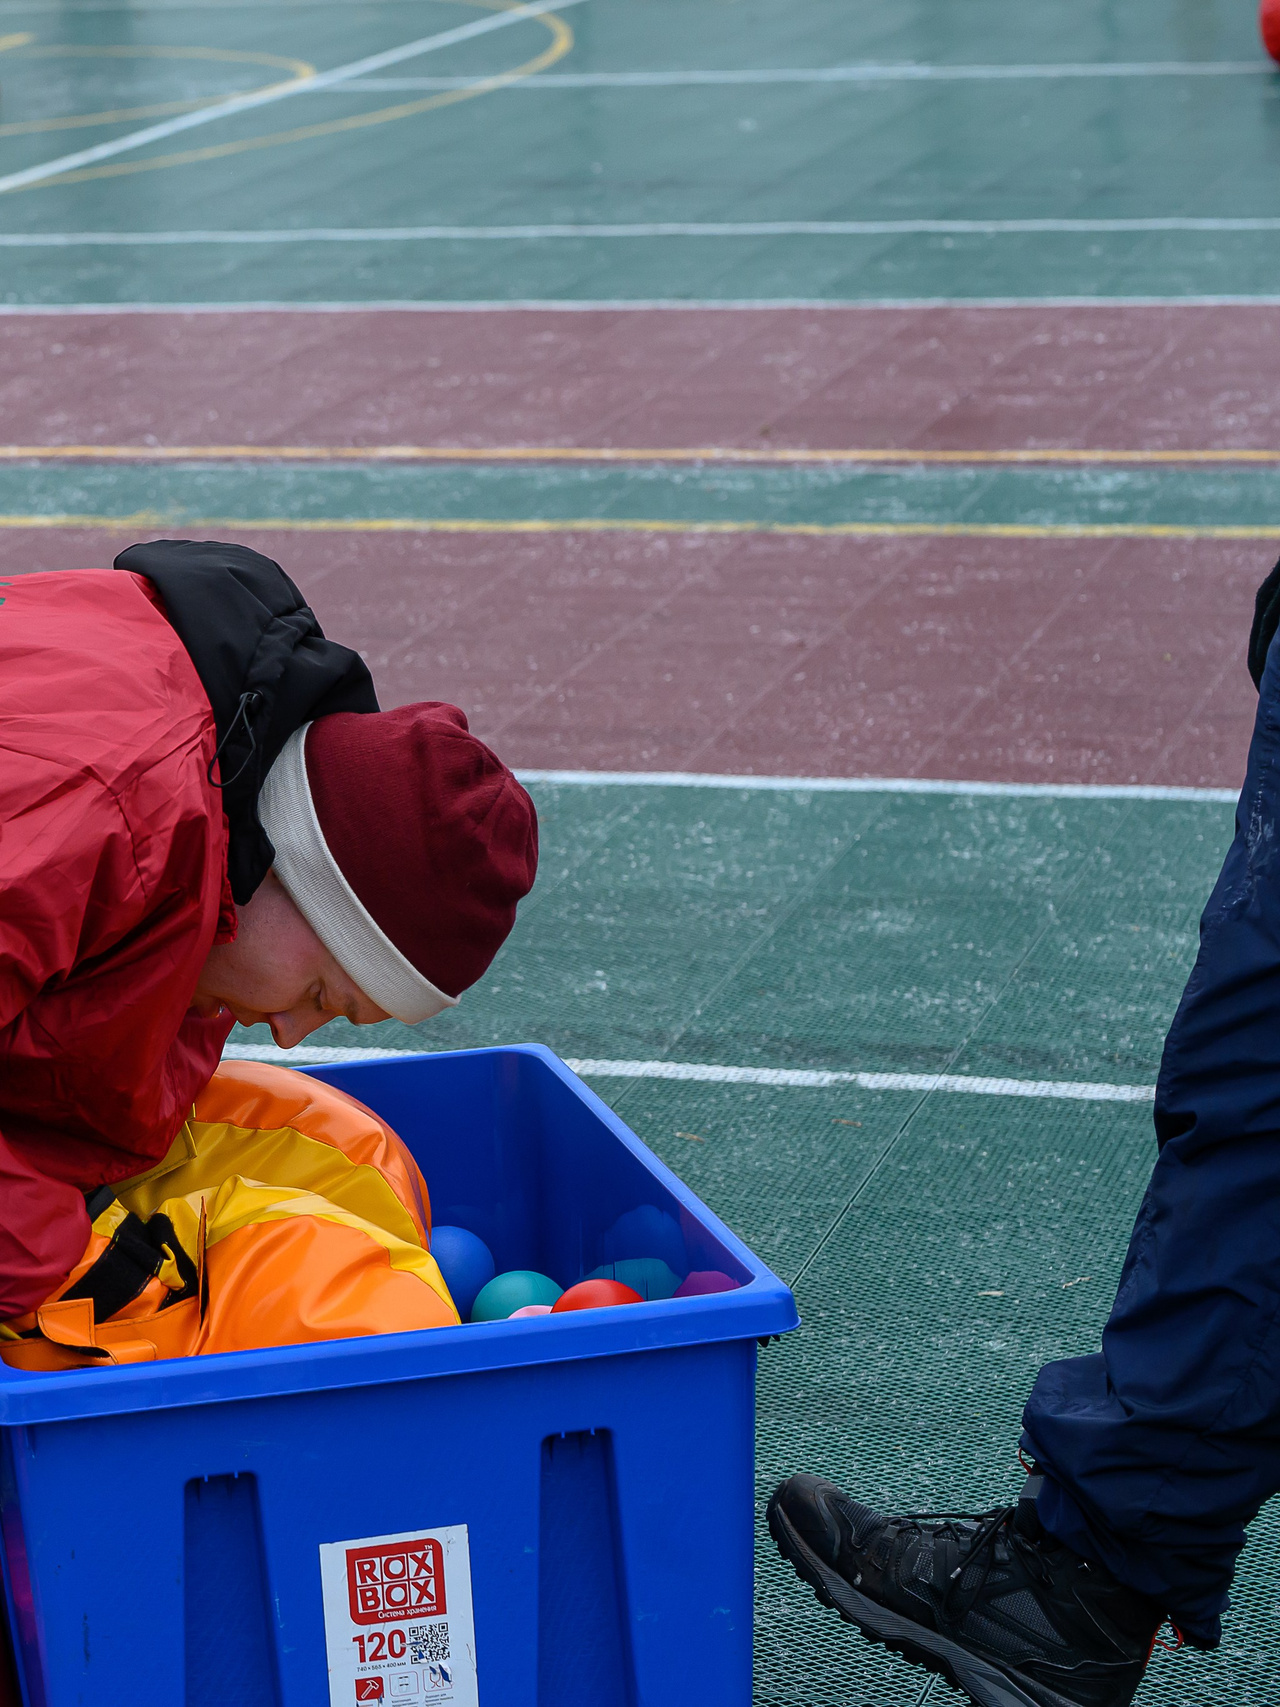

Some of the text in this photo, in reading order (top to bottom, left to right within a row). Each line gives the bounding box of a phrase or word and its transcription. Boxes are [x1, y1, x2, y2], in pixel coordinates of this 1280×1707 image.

[356, 1551, 434, 1584] ROX
[358, 1579, 436, 1612] BOX
[378, 1605, 437, 1619] Система хранения
[352, 1629, 407, 1663] 120
